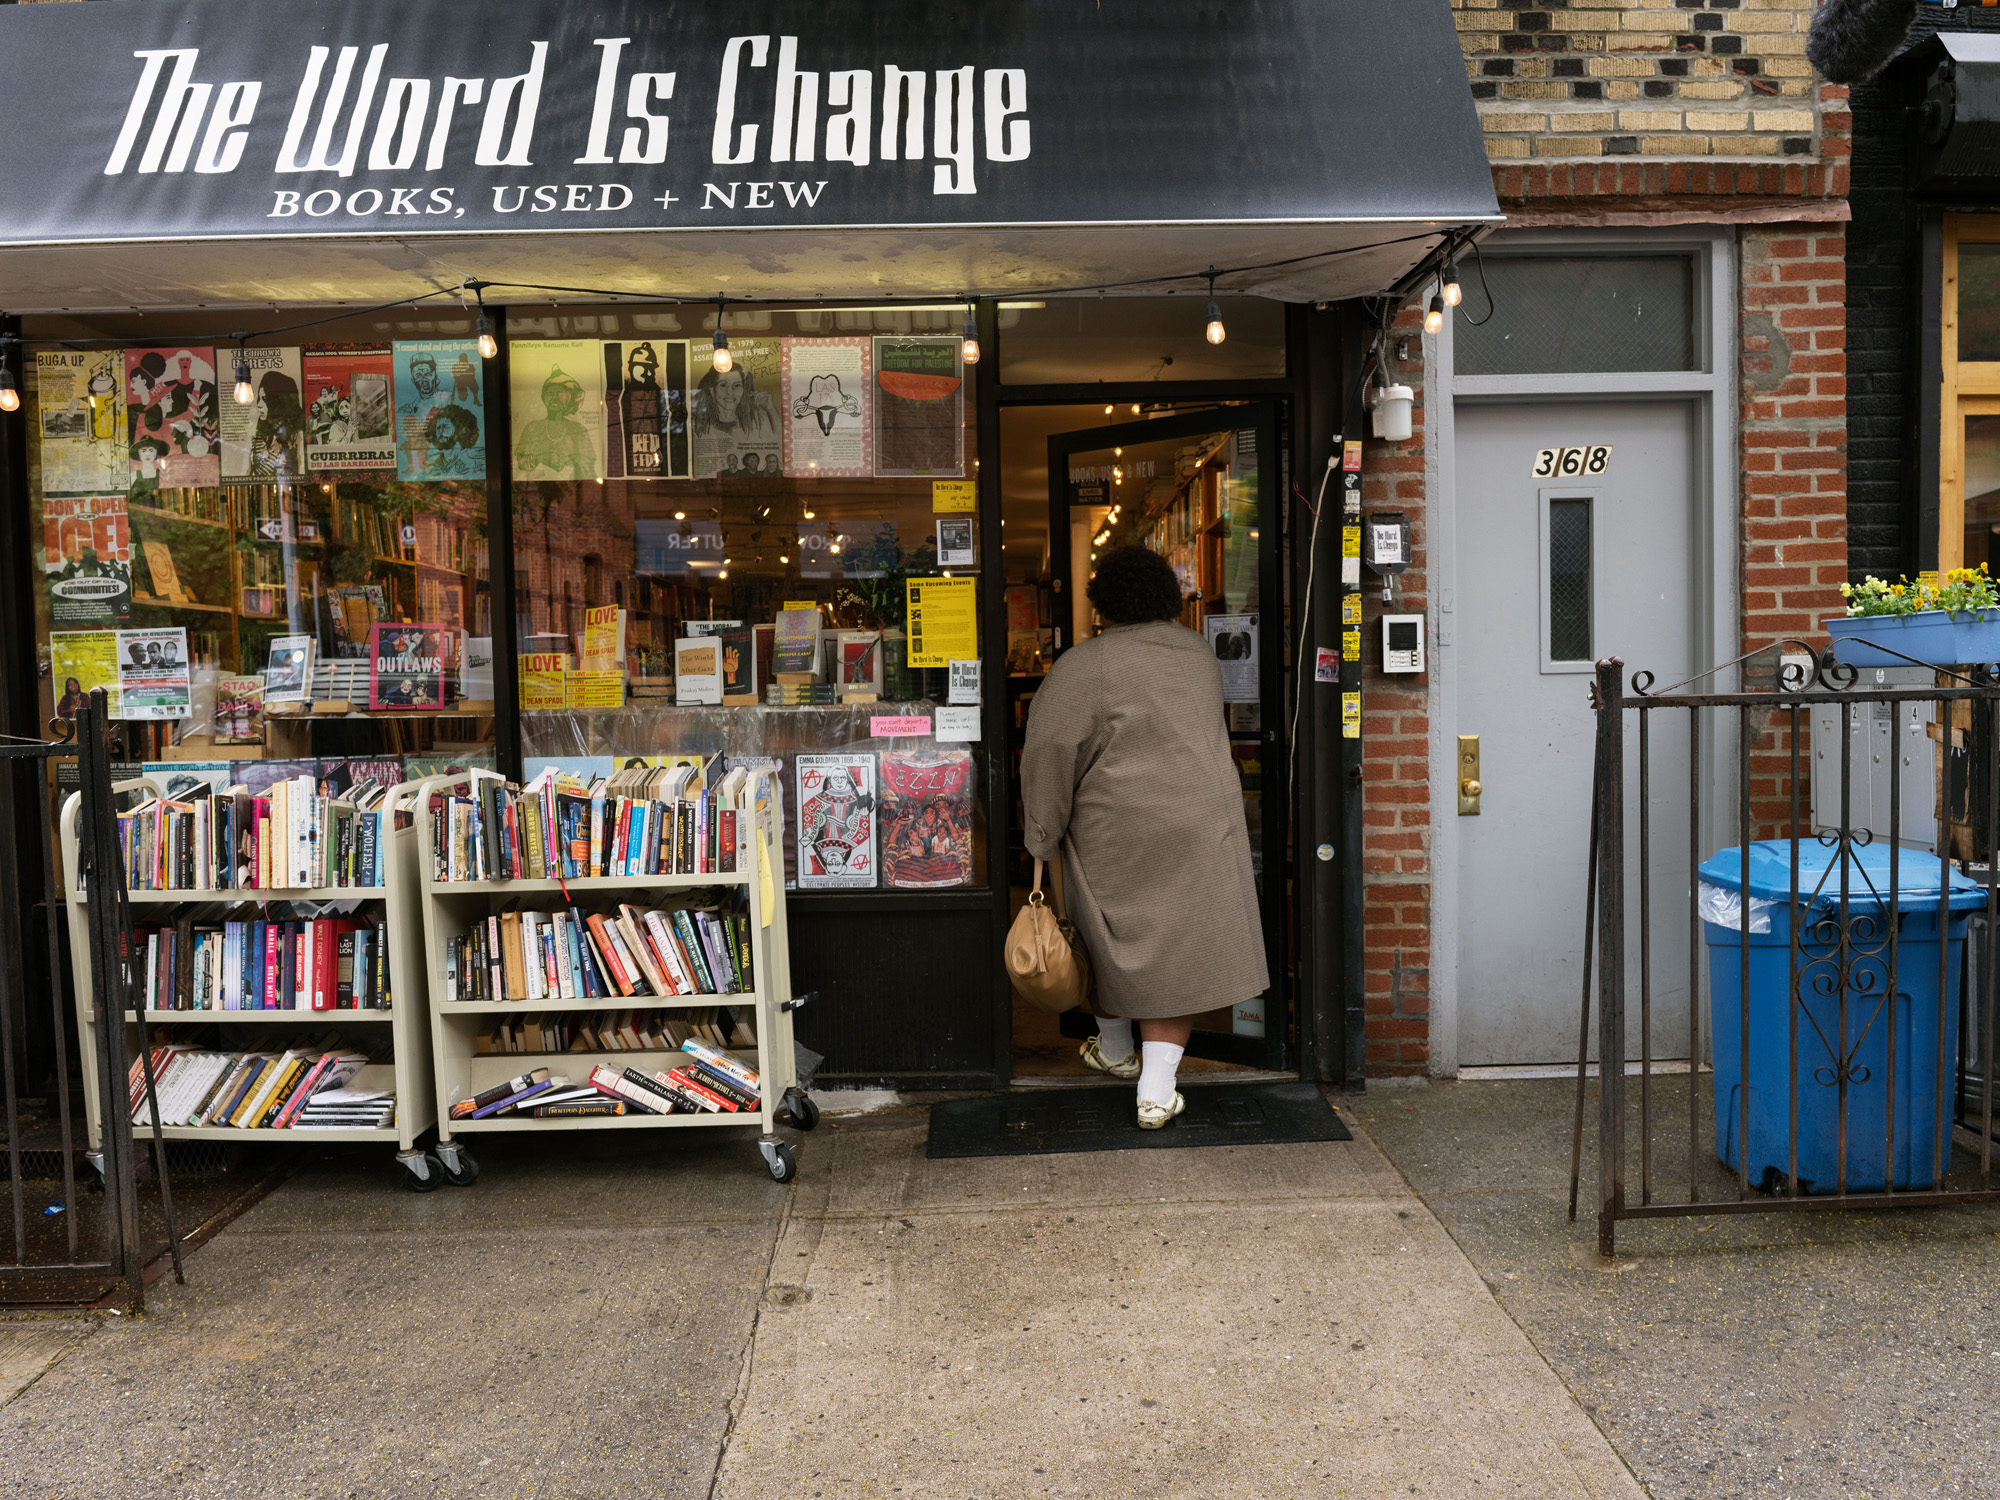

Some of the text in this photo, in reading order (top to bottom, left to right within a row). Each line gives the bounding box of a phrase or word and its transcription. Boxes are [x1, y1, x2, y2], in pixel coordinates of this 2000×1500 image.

[103, 34, 1031, 195] The Word Is Change
[266, 179, 829, 222] BOOKS, USED + NEW
[432, 342, 441, 351] and
[452, 341, 460, 350] the
[753, 347, 769, 355] FREE
[251, 349, 281, 357] BROWN
[753, 360, 781, 379] FREE
[884, 359, 953, 368] FREEDOM FOR PALESTINE
[815, 383, 836, 393] LAS
[632, 434, 660, 452] RED
[310, 450, 395, 461] GUERRERAS
[1535, 447, 1608, 476] 368
[341, 460, 395, 468] BARRICADAS
[1070, 466, 1099, 485] BOOKS,
[1136, 460, 1155, 478] NEW
[43, 496, 128, 516] DON'T OPEN
[44, 514, 129, 563] ICE!
[61, 585, 120, 595] COMMUNITIES!
[587, 606, 617, 626] LOVE
[585, 646, 617, 656] DEAN SPADE
[694, 653, 713, 661] World
[377, 656, 442, 674] OUTLAWS
[525, 655, 562, 672] LOVE
[961, 663, 977, 675] Word
[959, 675, 978, 690] Change
[218, 701, 262, 711] DANCE
[544, 696, 563, 704] SPADE
[1852, 706, 1857, 719] 2
[1913, 707, 1918, 720] 4
[875, 719, 887, 727] you
[904, 718, 922, 726] deport
[895, 769, 956, 790] EZLN
[527, 808, 536, 831] TERRY
[362, 826, 375, 870] WOLFISH
[529, 832, 538, 855] HAYES
[557, 915, 567, 938] OPTIMUM
[562, 956, 570, 981] NUTRITION
[648, 916, 678, 971] FIRE AND FURY
[606, 949, 614, 961] SUSAN
[690, 948, 700, 966] WATER
[266, 985, 274, 998] MAY
[1239, 1010, 1260, 1020] TAMA
[657, 1073, 665, 1083] JAY
[625, 1069, 645, 1085] EARTH
[654, 1085, 678, 1102] BALANCE
[578, 1106, 609, 1115] DAUGHTER
